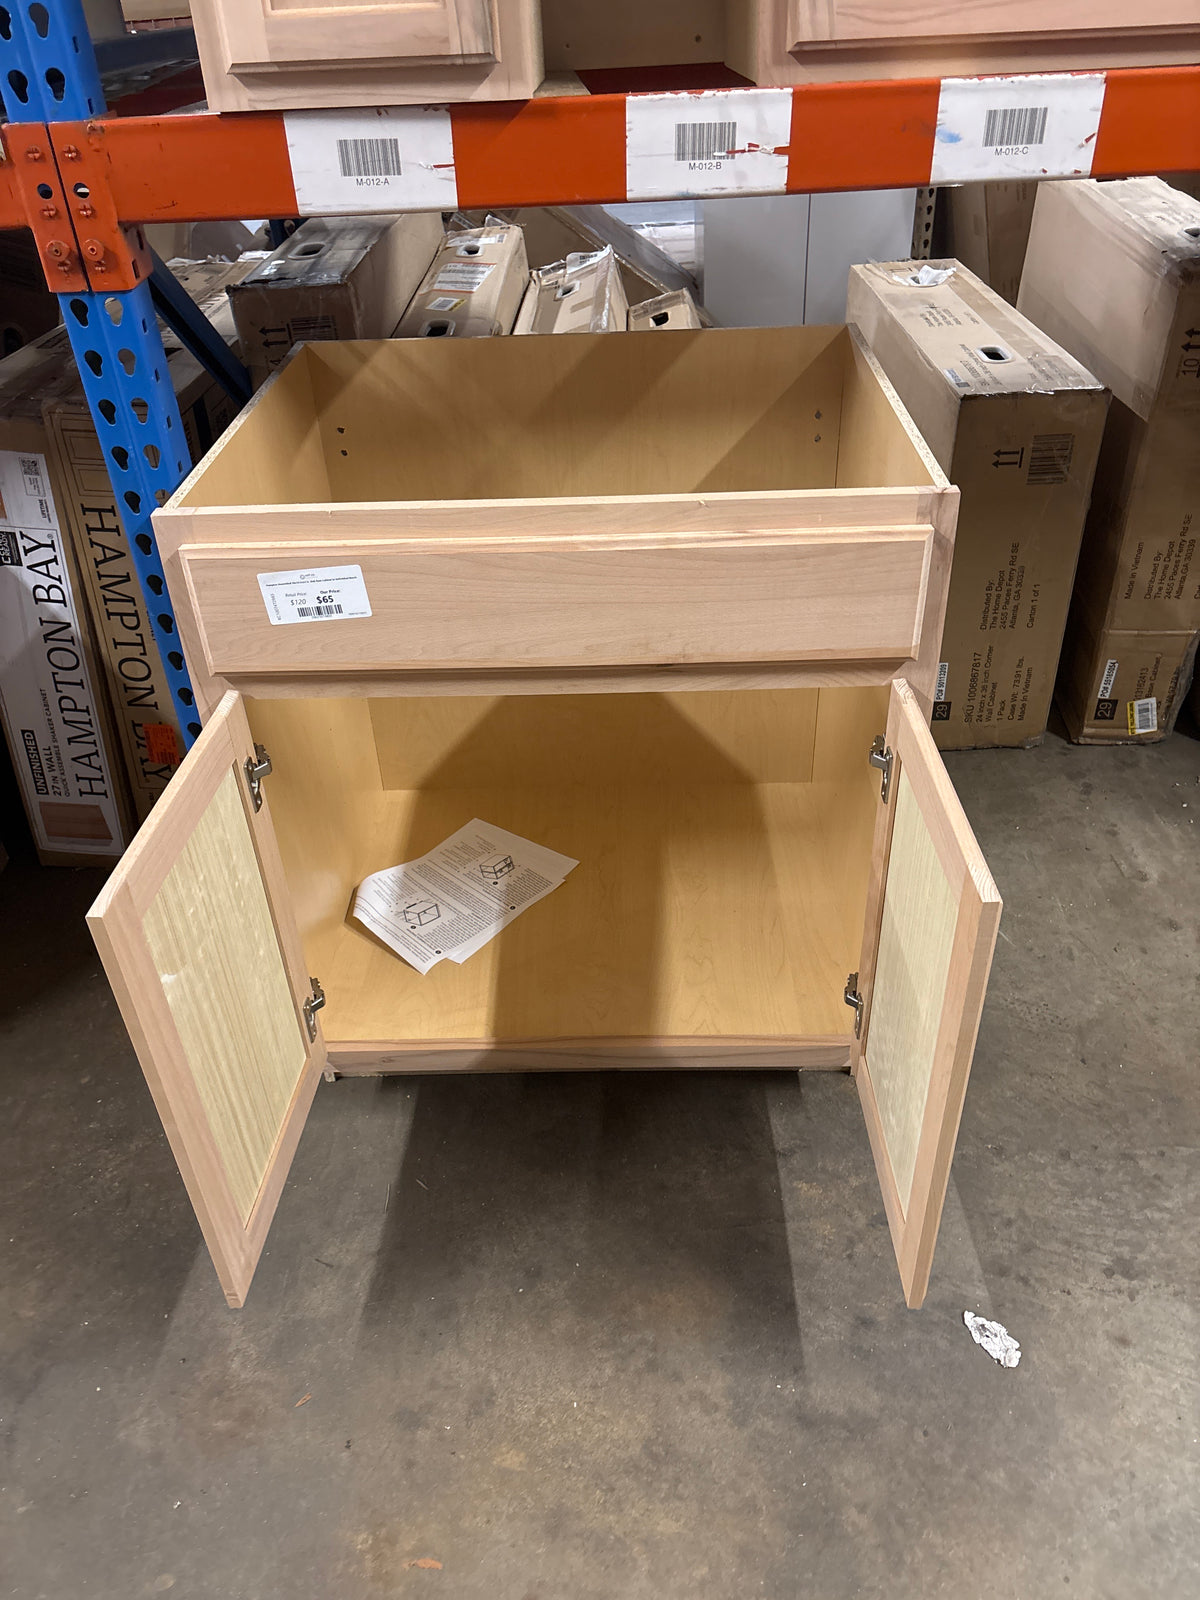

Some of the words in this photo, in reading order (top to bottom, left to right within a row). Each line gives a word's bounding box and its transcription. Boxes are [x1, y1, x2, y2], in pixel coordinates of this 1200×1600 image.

[994, 146, 1029, 156] M-012-C
[689, 161, 722, 171] M-012-B
[356, 177, 390, 186] M-012-A
[1180, 526, 1189, 537] Rd
[1011, 542, 1020, 554] SE
[1163, 541, 1175, 563] Depot
[1174, 538, 1187, 558] Ferry
[1186, 538, 1197, 562] 30339
[19, 530, 67, 608] BAY
[1008, 555, 1018, 566] Rd
[1168, 559, 1181, 581] Paces
[1005, 568, 1016, 587] Ferry
[1124, 580, 1135, 600] Made
[1131, 541, 1144, 571] Vietnam
[1157, 564, 1169, 585] Home
[995, 570, 1005, 592] Depot
[1144, 563, 1159, 600] Distributed
[316, 595, 334, 604] $65
[1002, 588, 1012, 611] Paces
[1013, 589, 1021, 601] GA
[1153, 586, 1163, 600] The
[1164, 582, 1174, 600] 2455
[80, 503, 160, 711] HAMPTON
[290, 598, 307, 606] $120
[992, 594, 1001, 615] Home
[980, 593, 992, 631] Distributed
[999, 612, 1008, 630] 2455
[1026, 605, 1037, 629] Carton
[990, 616, 998, 630] The
[984, 645, 994, 669] Corner
[1015, 656, 1025, 669] lbs.
[982, 670, 990, 684] inch
[1012, 670, 1022, 689] 73.91
[1021, 667, 1033, 695] Vietnam
[40, 688, 51, 716] CABINET
[986, 682, 998, 707] Cabinet
[39, 616, 108, 799] HAMPTON
[935, 704, 948, 718] 29
[964, 704, 975, 724] SKU
[977, 699, 986, 714] inch
[985, 708, 993, 722] Wall
[997, 699, 1006, 716] Pack
[1008, 704, 1017, 721] Case
[1018, 703, 1027, 721] Made
[1097, 702, 1112, 718] 29
[976, 714, 983, 723] 24
[47, 718, 58, 743] SHAKER
[24, 731, 47, 794] UNFINISHED
[43, 745, 56, 773] WALL
[54, 745, 65, 776] ASSEMBLE
[51, 775, 58, 784] IN
[61, 777, 70, 797] QUICK
[53, 784, 61, 797] 27
